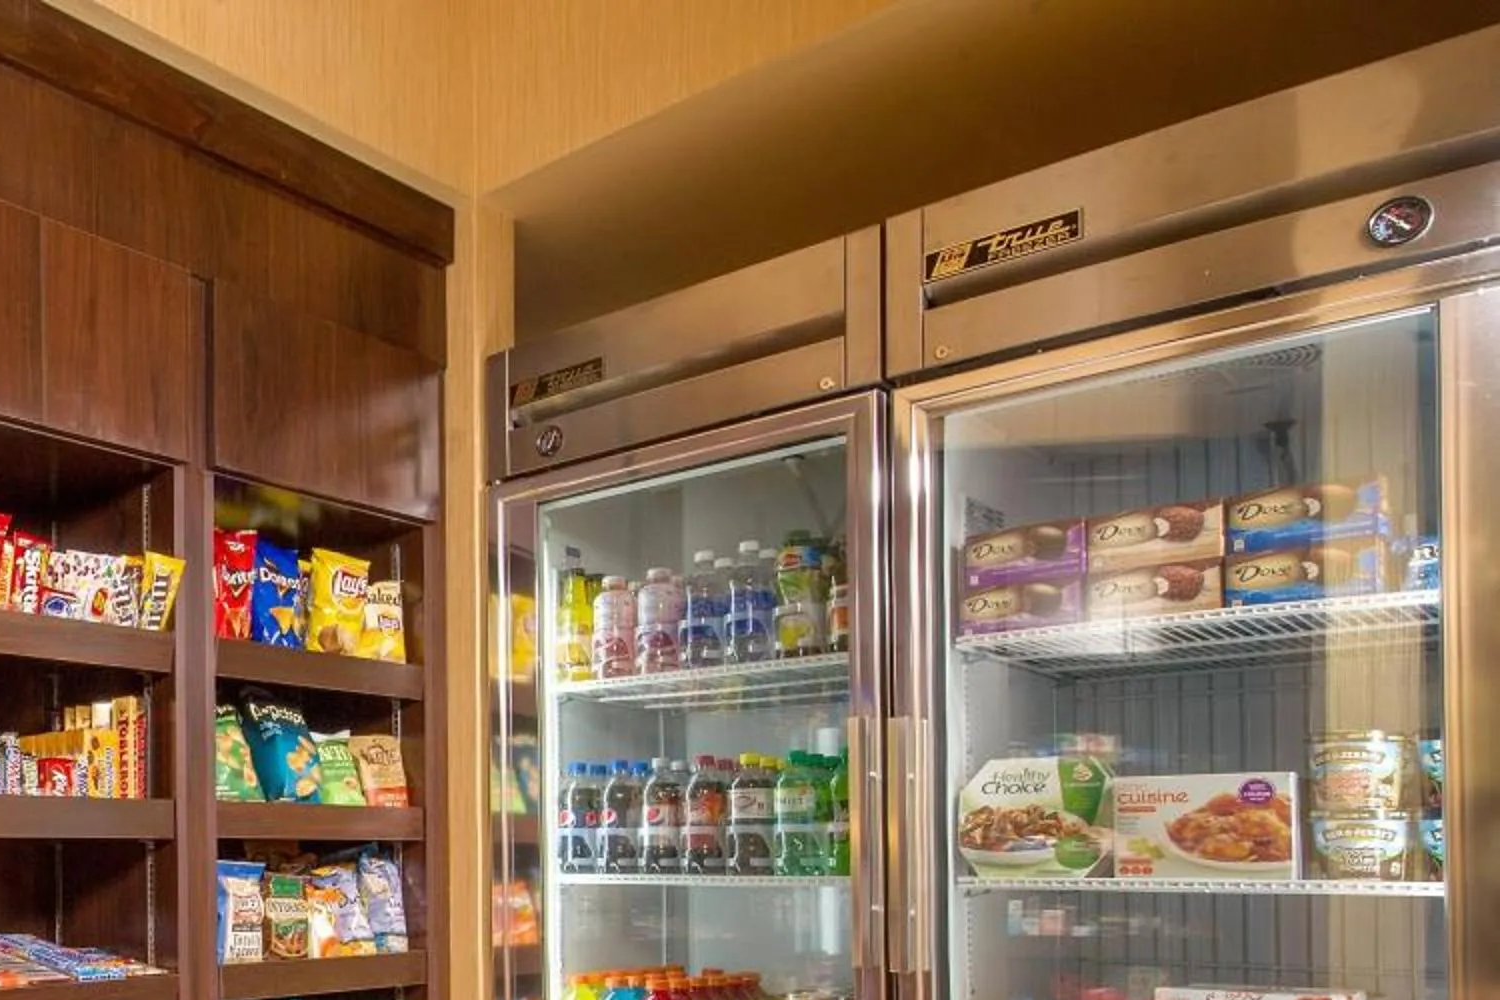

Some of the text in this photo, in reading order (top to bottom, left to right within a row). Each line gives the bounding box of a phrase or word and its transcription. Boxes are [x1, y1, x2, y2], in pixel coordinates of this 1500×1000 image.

[367, 587, 402, 605] aked
[981, 780, 1047, 796] Choice
[1117, 788, 1190, 804] cuisine
